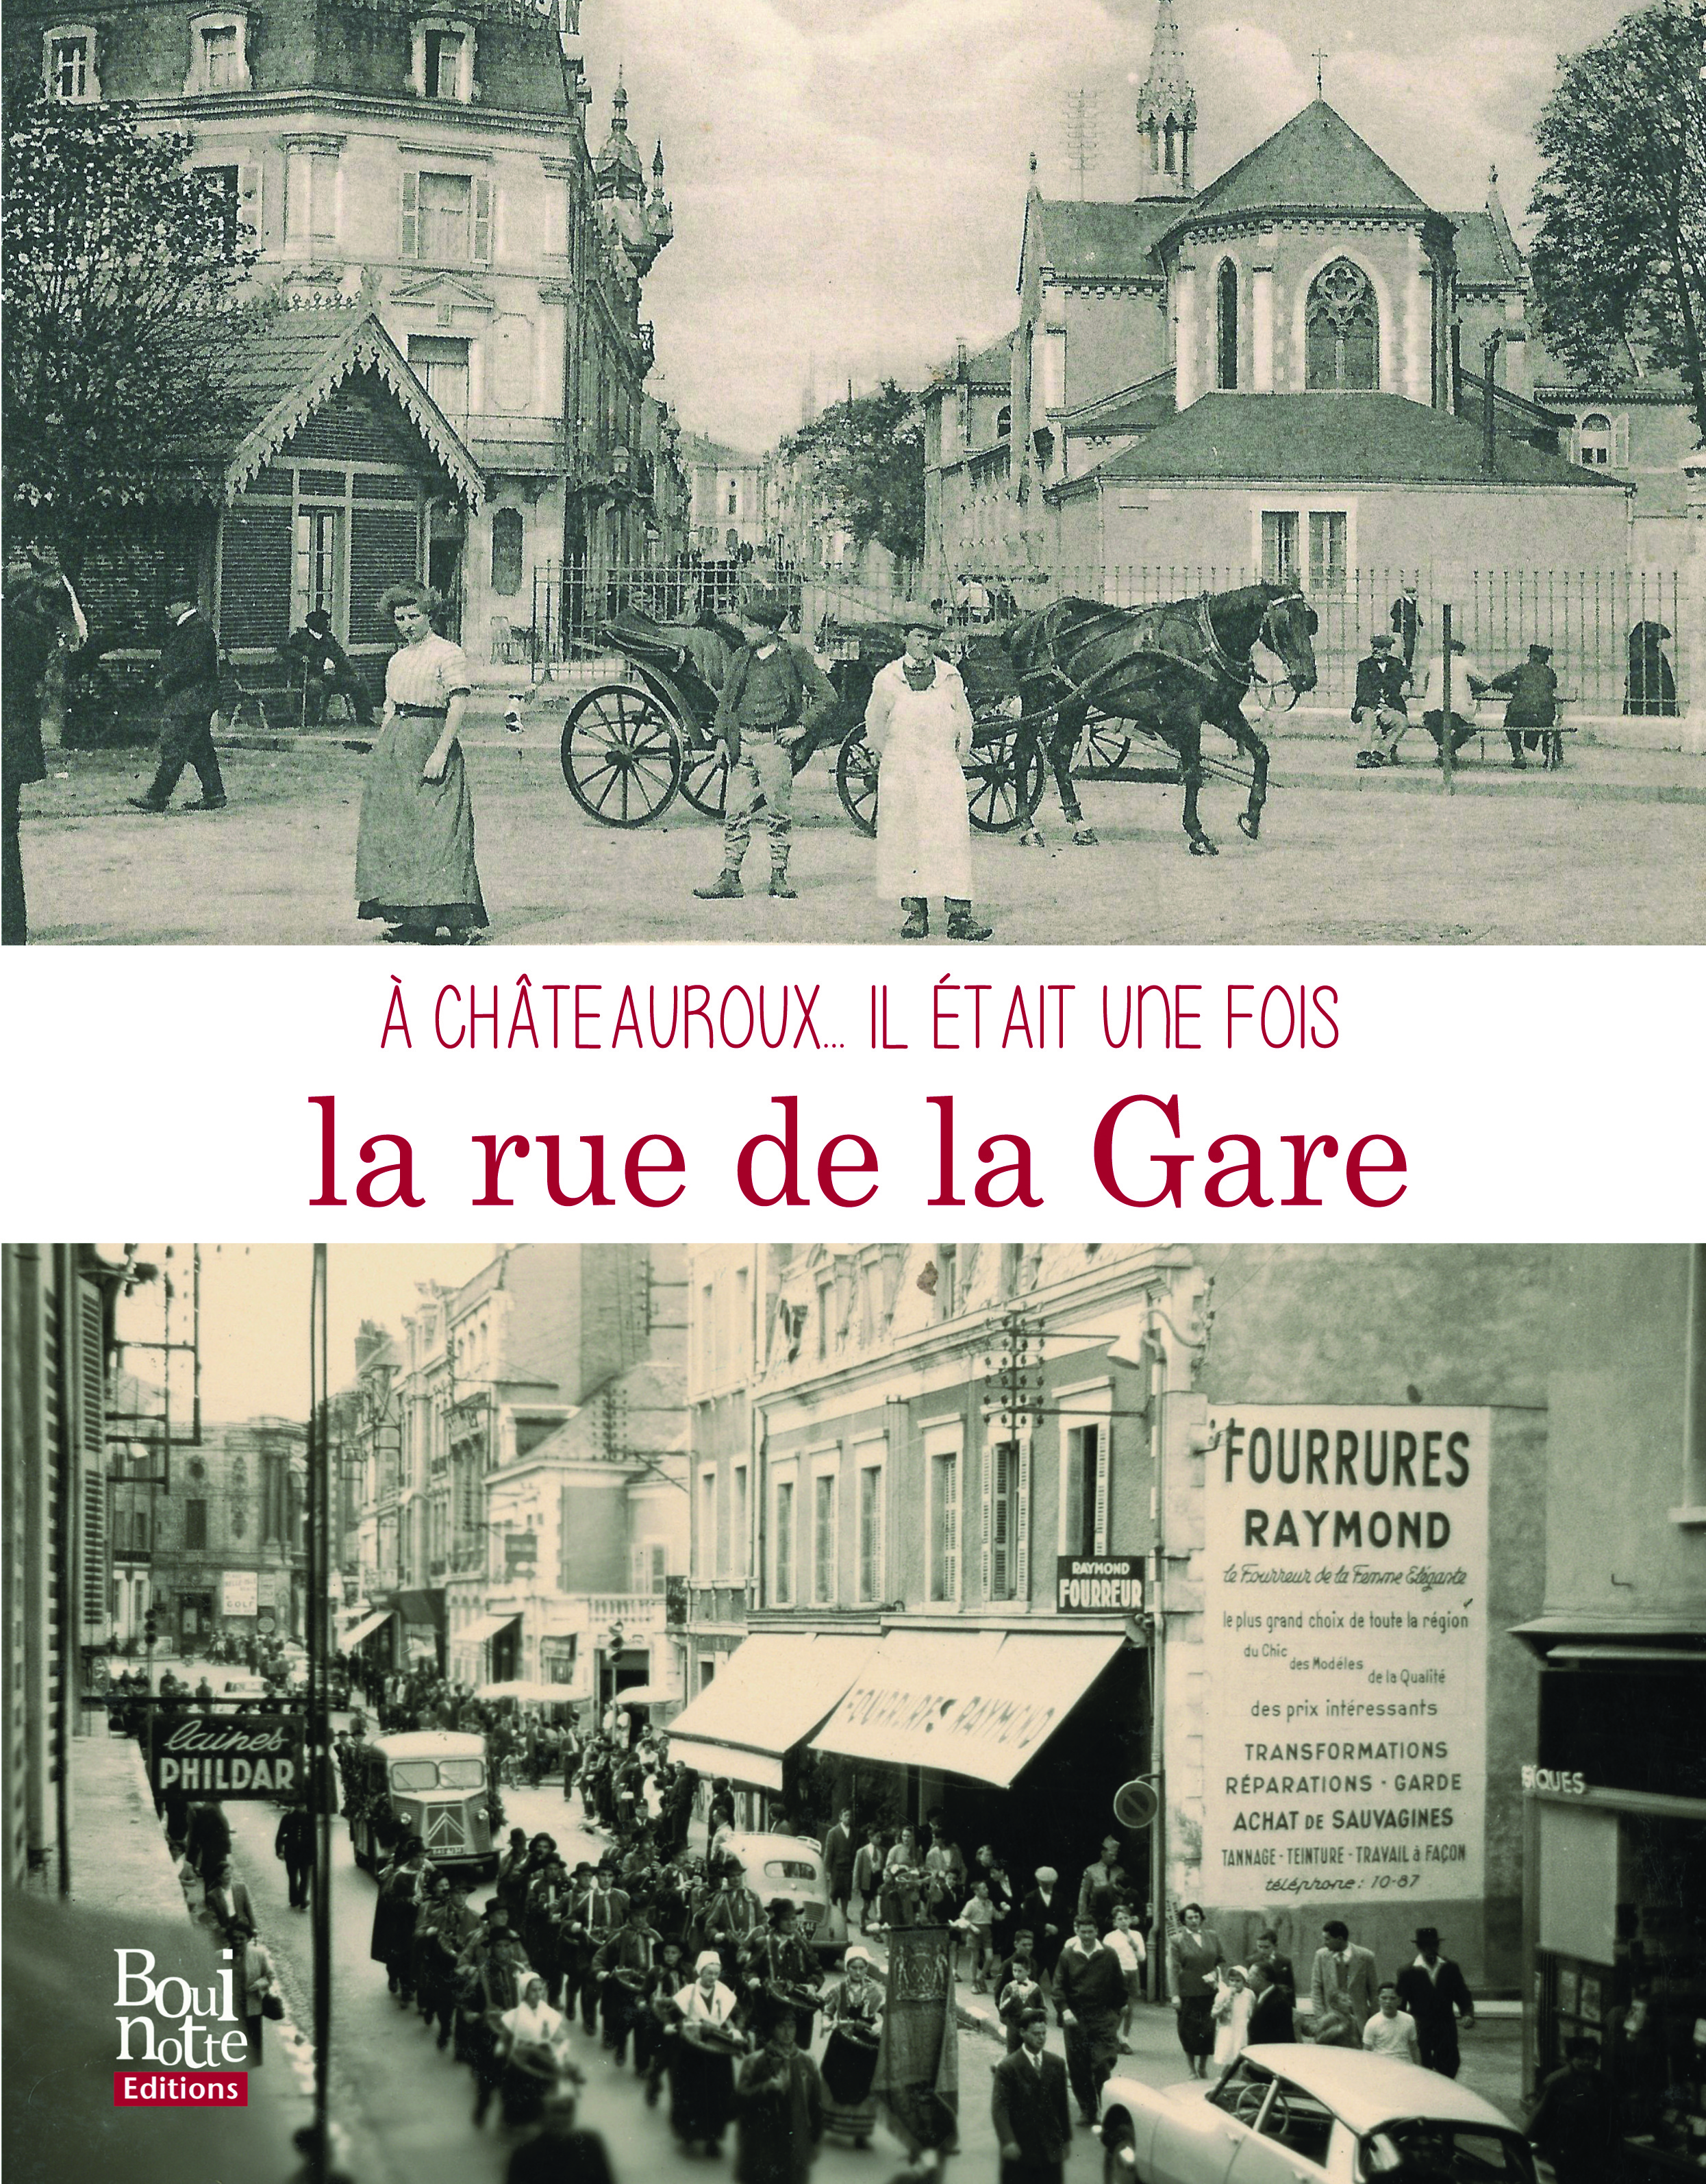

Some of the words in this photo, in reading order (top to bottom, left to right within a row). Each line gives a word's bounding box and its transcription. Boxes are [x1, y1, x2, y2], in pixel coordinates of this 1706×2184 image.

[1225, 1425, 1470, 1488] FOURRURES
[1244, 1509, 1451, 1550] RAYMOND
[1071, 1561, 1131, 1576] RAYMOND
[1240, 1563, 1312, 1584] Fourreur
[1314, 1566, 1332, 1584] de
[1333, 1564, 1350, 1584] la
[1352, 1564, 1403, 1585] Femme
[1059, 1578, 1143, 1609] FOURREUR
[1223, 1610, 1233, 1628] le
[1235, 1610, 1262, 1632] plus
[1266, 1611, 1303, 1633] grand
[1308, 1609, 1344, 1629] choix
[1349, 1611, 1365, 1629] de
[1368, 1610, 1403, 1629] toute
[1406, 1611, 1418, 1629] la
[1422, 1611, 1469, 1634] région
[1243, 1644, 1259, 1657] du
[1262, 1643, 1288, 1657] Chic
[1289, 1657, 1309, 1670] des
[1367, 1669, 1383, 1684] de
[1385, 1669, 1397, 1684] la
[1399, 1668, 1446, 1687] Qualité
[1251, 1699, 1281, 1717] des
[1286, 1698, 1319, 1723] prix
[1326, 1698, 1438, 1717] intéressants
[1244, 1741, 1448, 1761] TRANSFORMATIONS
[160, 1758, 294, 1790] PHILDAR
[1225, 1773, 1373, 1794] RÉPARATIONS
[1394, 1772, 1462, 1792] GARDE
[1232, 1810, 1300, 1832] ACHAT
[1304, 1813, 1325, 1831] DE
[1331, 1807, 1454, 1830] SAUVAGINES
[1222, 1848, 1277, 1866] TANNAGE
[1286, 1846, 1344, 1866] TEINTURE
[1356, 1845, 1410, 1864] TRAVAIL
[1425, 1844, 1467, 1864] FAÇON
[1370, 1874, 1421, 1889] 10-87
